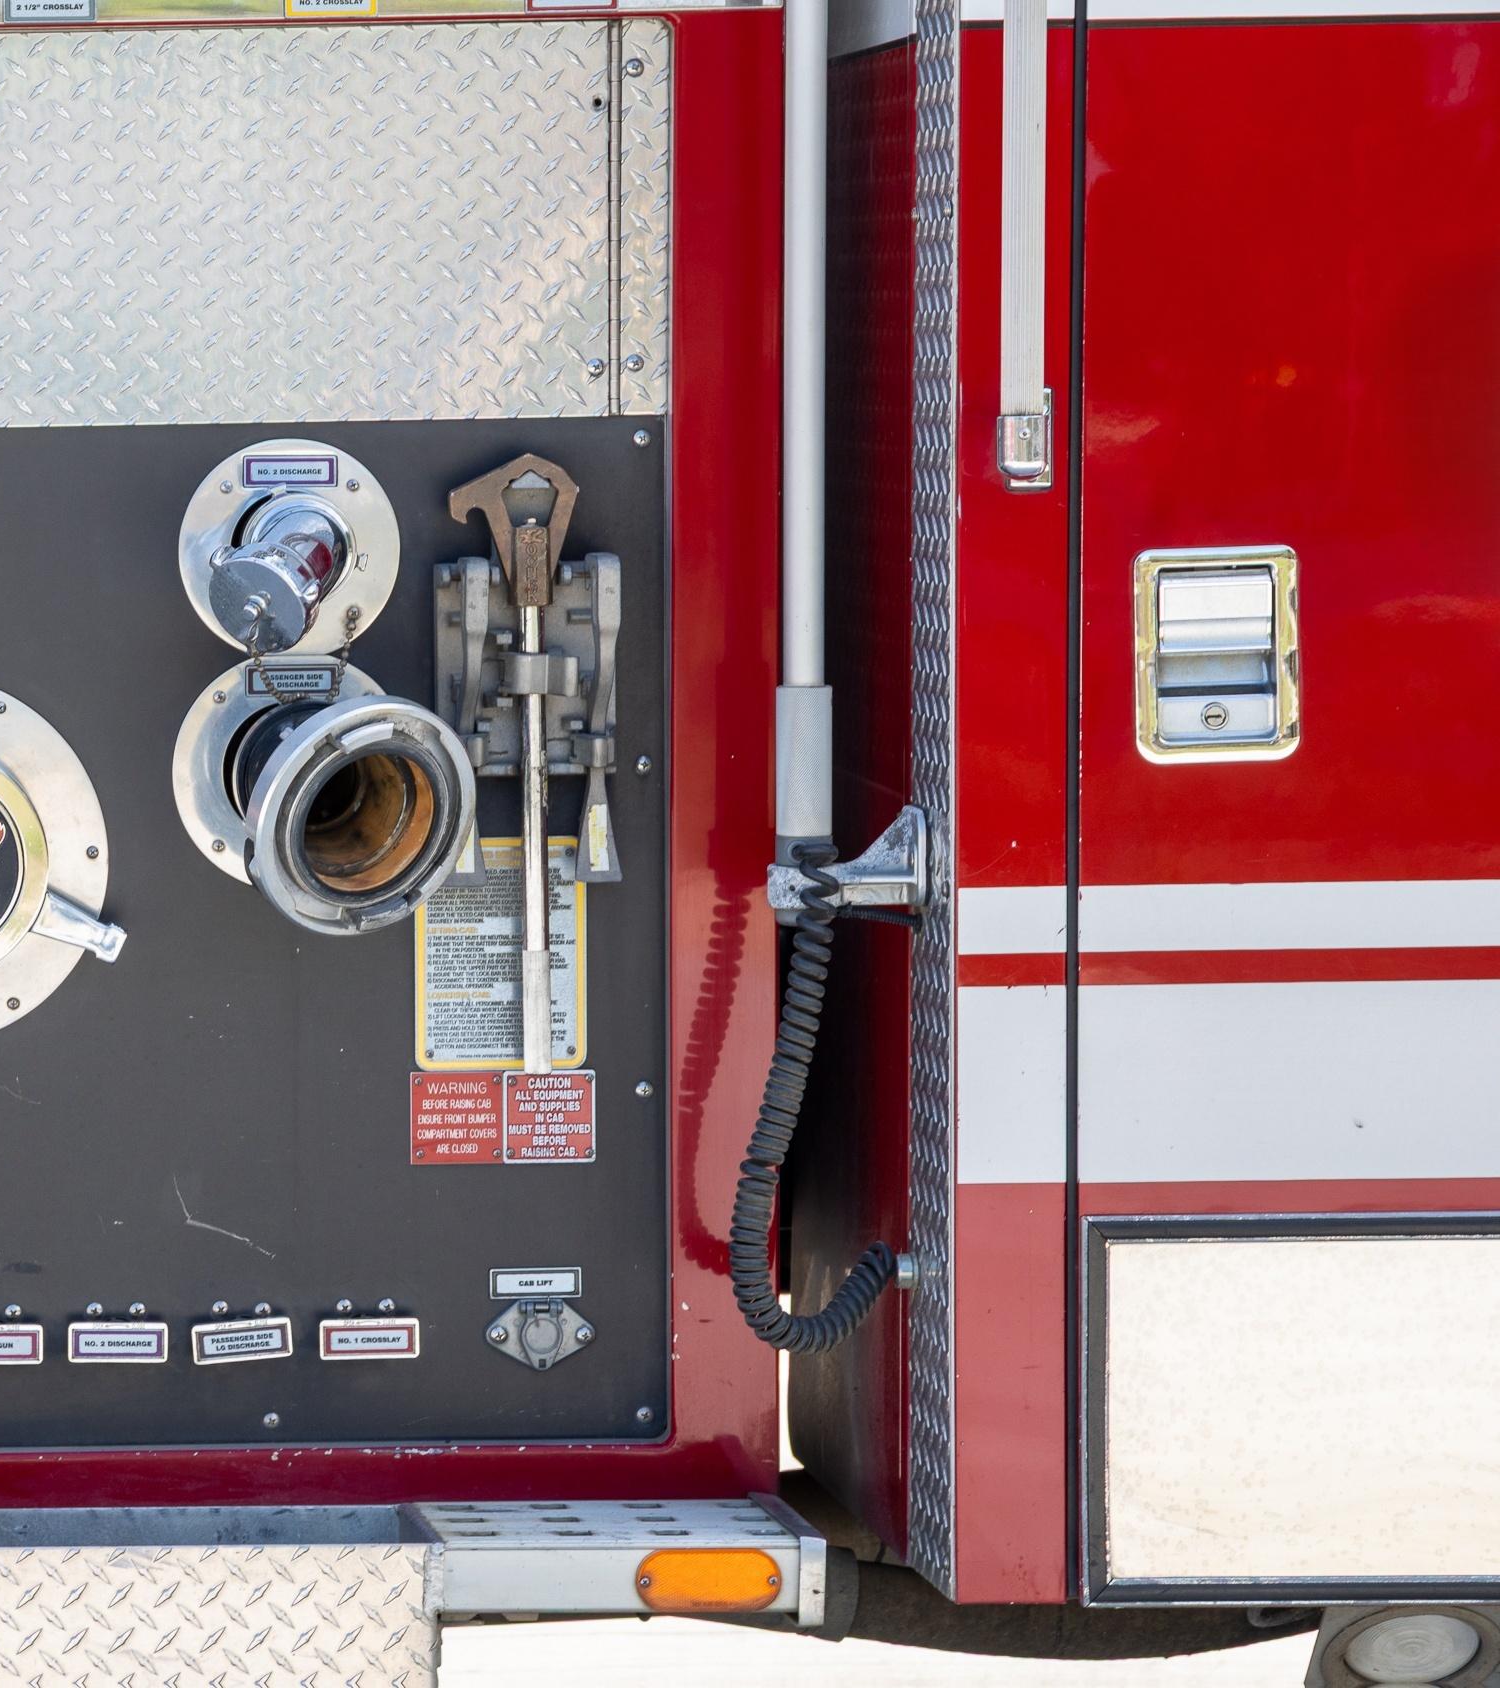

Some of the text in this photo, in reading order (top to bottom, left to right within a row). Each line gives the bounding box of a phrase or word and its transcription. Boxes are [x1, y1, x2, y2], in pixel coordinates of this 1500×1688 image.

[427, 1082, 487, 1095] WARNING
[528, 1077, 571, 1089] CAUTION
[515, 1090, 584, 1100] ALL EQUIPMENT
[423, 1099, 491, 1109] BEFORE RAISING CAB
[519, 1101, 580, 1112] AND SUPPLIES
[418, 1113, 496, 1125] ENSURE FRONT BUMPER
[535, 1113, 564, 1122] IN CAB
[417, 1129, 497, 1140] COMPARTMENT COVERS
[509, 1124, 591, 1135] MUST BE REMOVED
[533, 1136, 567, 1146] BEFORE
[436, 1144, 478, 1154] ARE CLOSED
[521, 1147, 578, 1158] RAISING CAB.
[211, 1332, 274, 1344] PASSENGER SIDE
[361, 1336, 401, 1344] CROSSLAY
[228, 1341, 270, 1351] DISCHARGE
